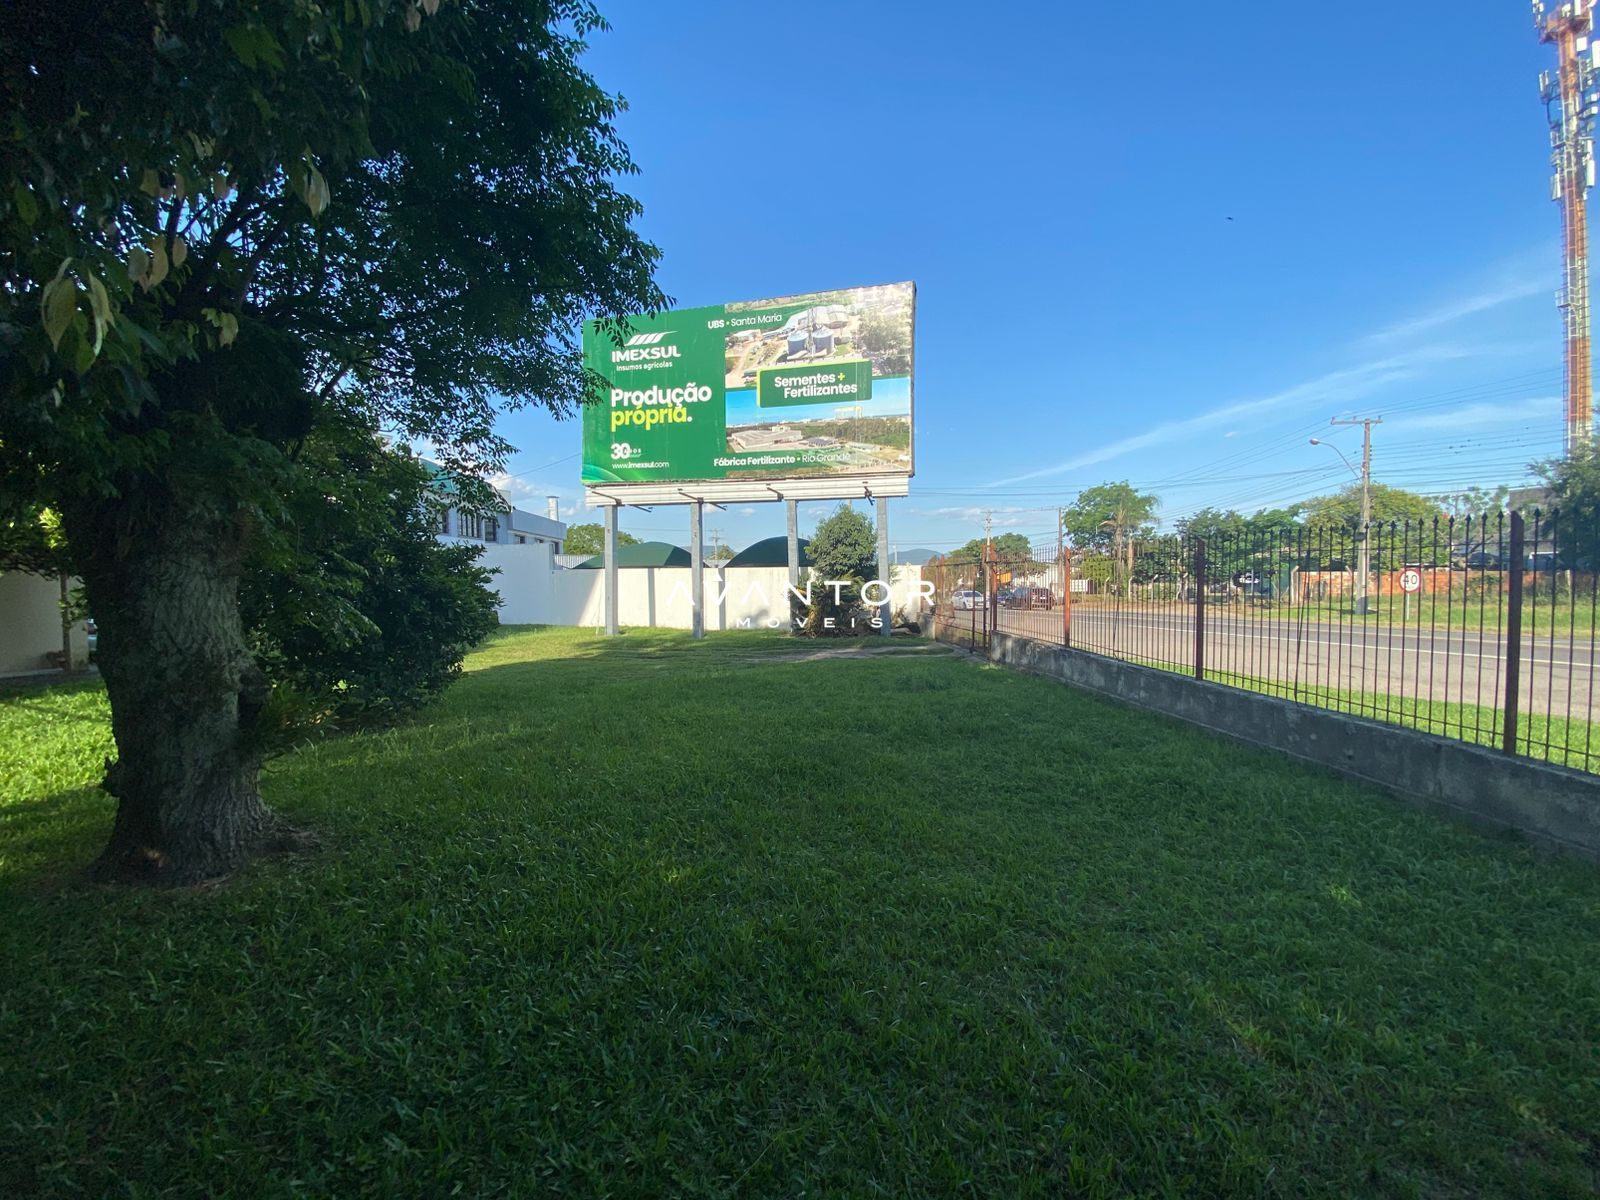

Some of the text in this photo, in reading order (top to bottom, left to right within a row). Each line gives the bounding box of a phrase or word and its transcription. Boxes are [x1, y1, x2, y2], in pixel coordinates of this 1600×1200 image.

[707, 313, 782, 329] UBS Santa Maria
[611, 345, 681, 362] IMEXSUL
[774, 373, 836, 388] Sementes
[611, 382, 712, 408] Produção
[783, 383, 858, 399] Fertilizantes
[611, 402, 693, 432] própria.
[610, 442, 631, 460] 30
[713, 456, 747, 467] Fábrica
[747, 454, 796, 466] Fertilizante
[802, 454, 816, 463] Rio
[1402, 574, 1418, 585] 40
